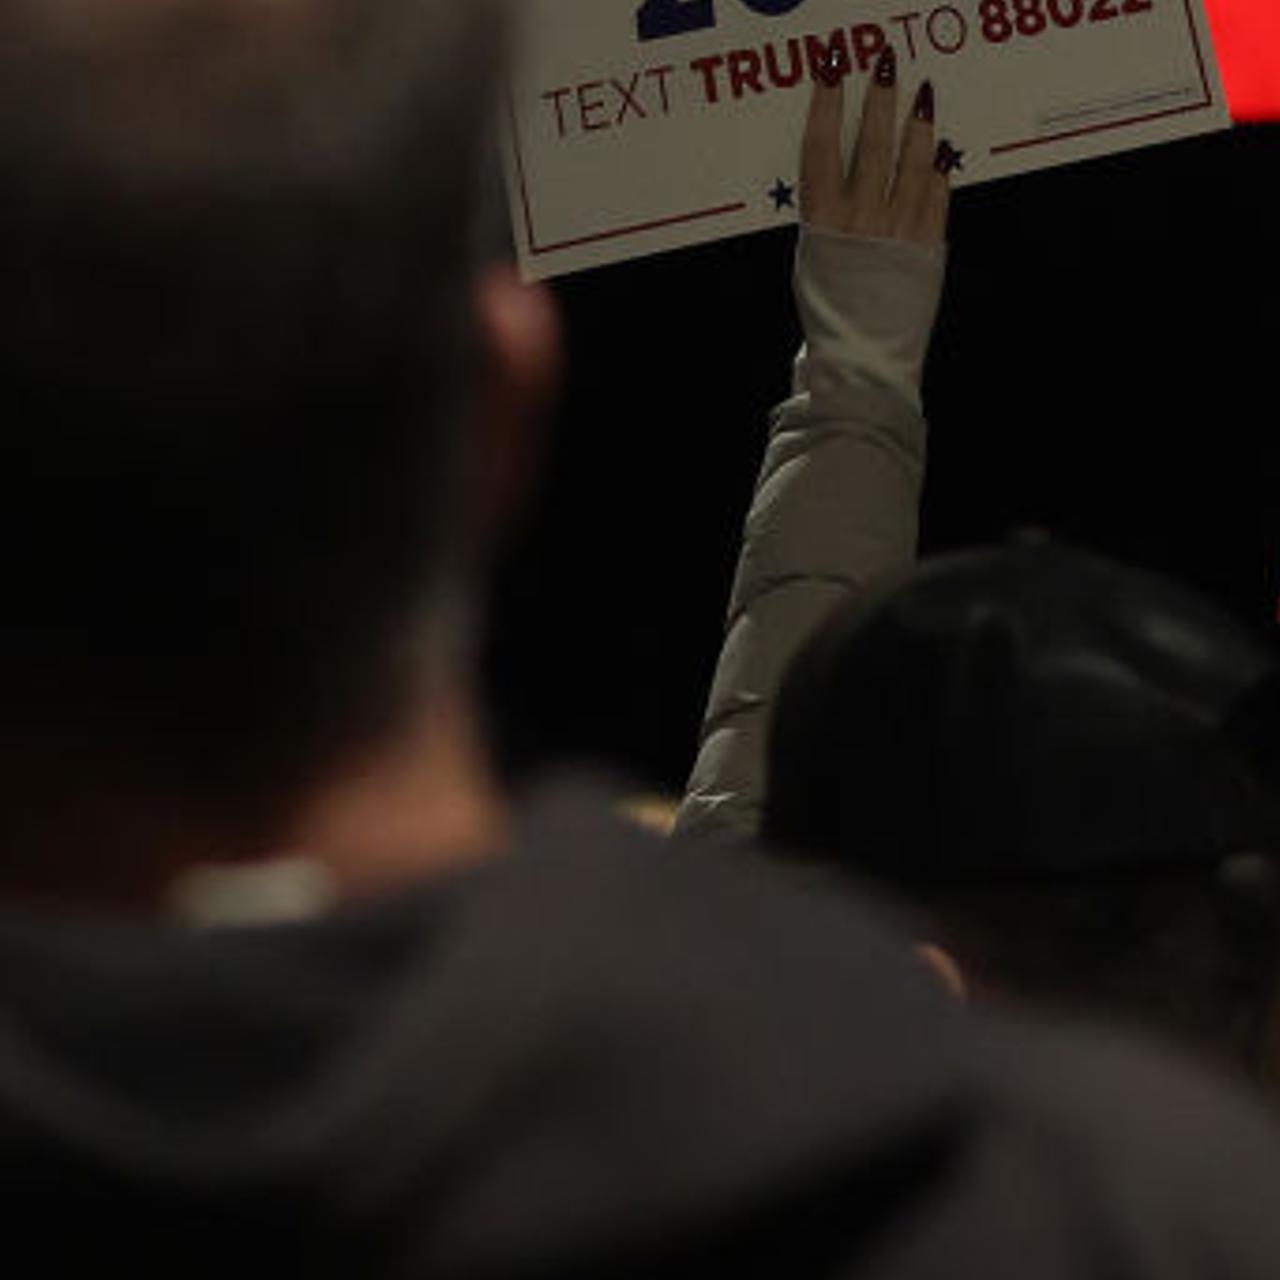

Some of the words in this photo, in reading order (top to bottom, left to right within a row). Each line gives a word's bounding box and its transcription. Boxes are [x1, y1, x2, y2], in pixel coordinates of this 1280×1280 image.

[543, 64, 673, 138] TEXT
[690, 21, 885, 103] TRUMP
[890, 5, 968, 61] TO
